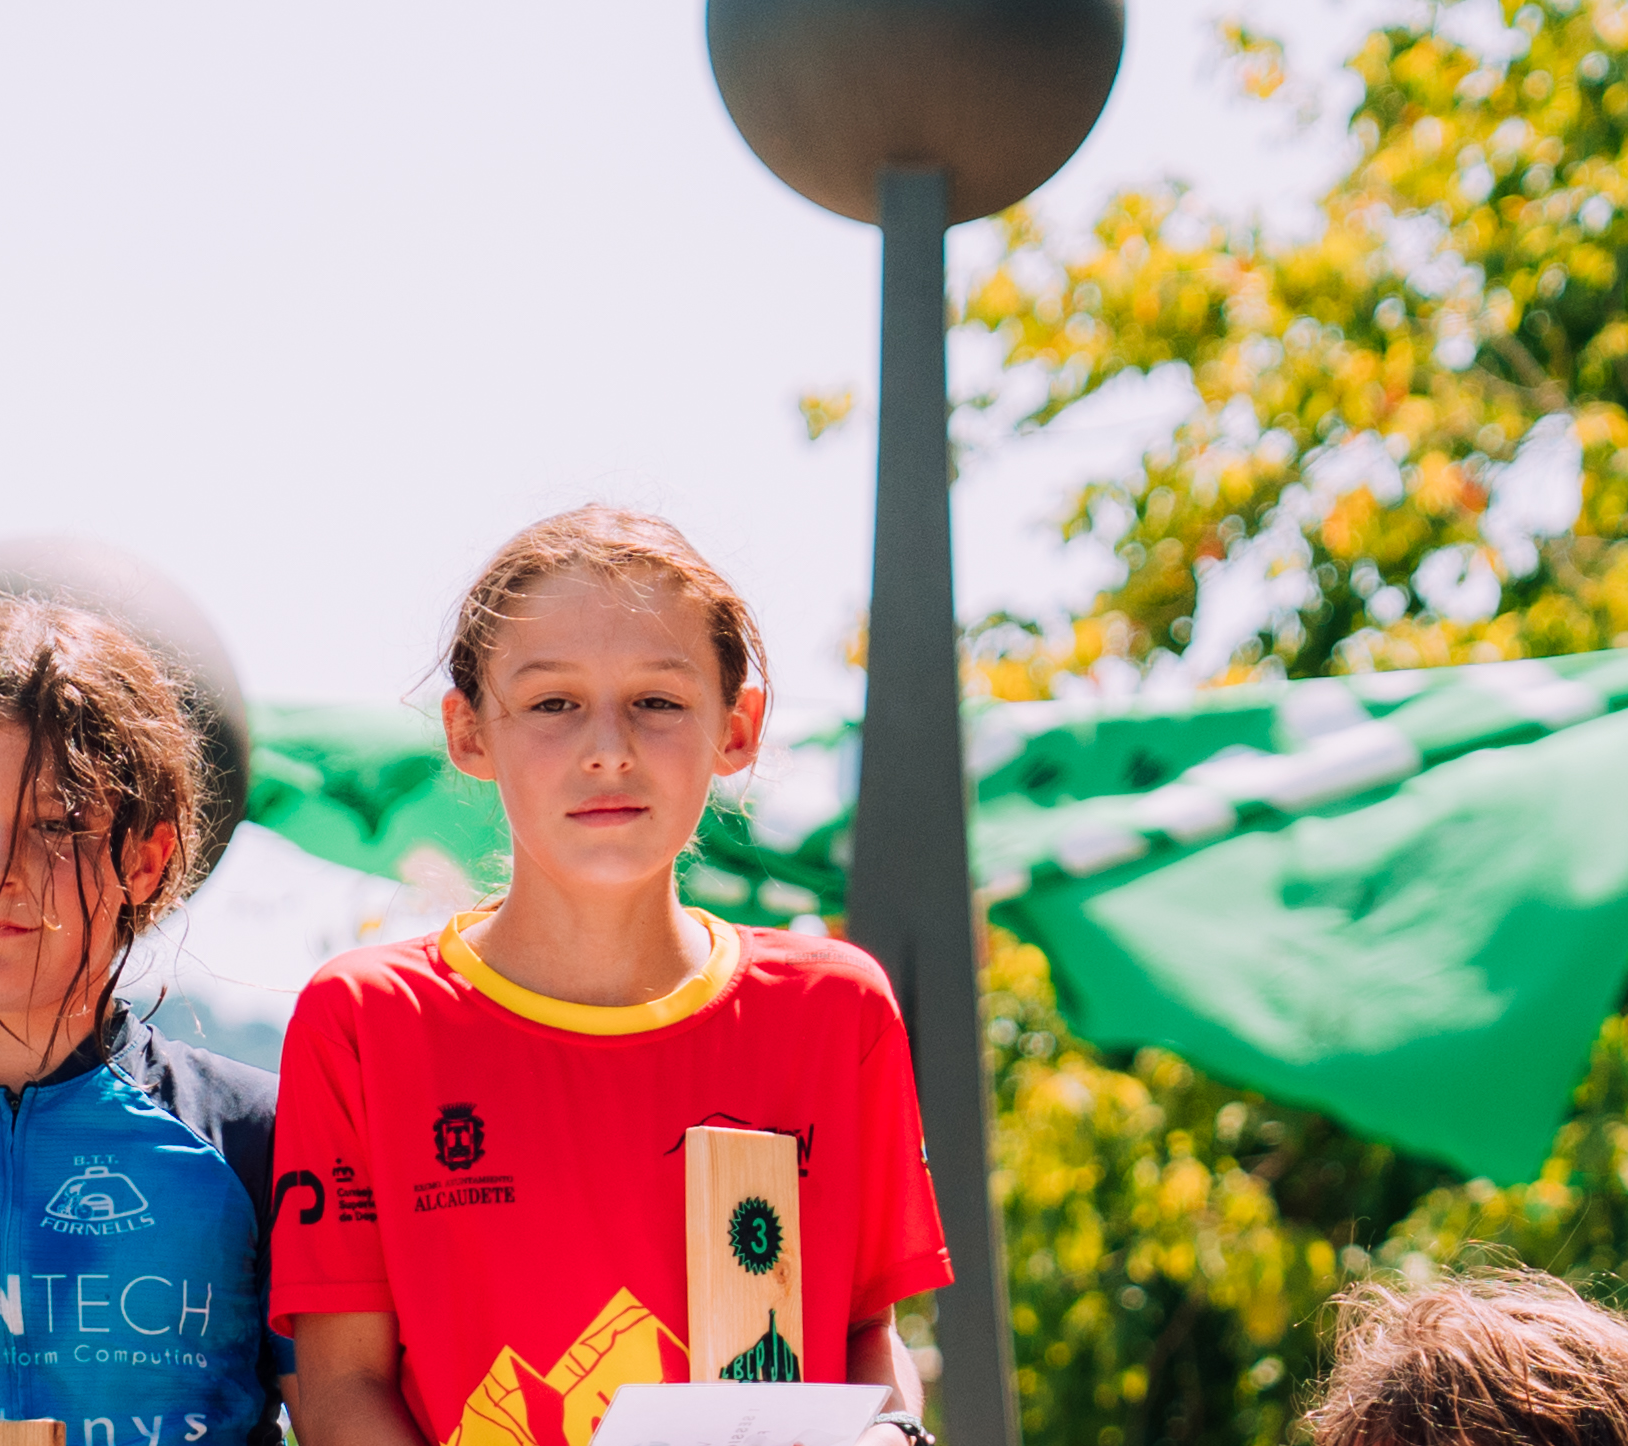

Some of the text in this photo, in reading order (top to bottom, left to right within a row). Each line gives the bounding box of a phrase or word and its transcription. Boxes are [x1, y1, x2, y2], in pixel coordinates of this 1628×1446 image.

[414, 1186, 516, 1212] ALCAUDETE
[39, 1212, 155, 1236] FORNELLS
[751, 1218, 768, 1254] 3
[73, 1343, 209, 1369] Computing
